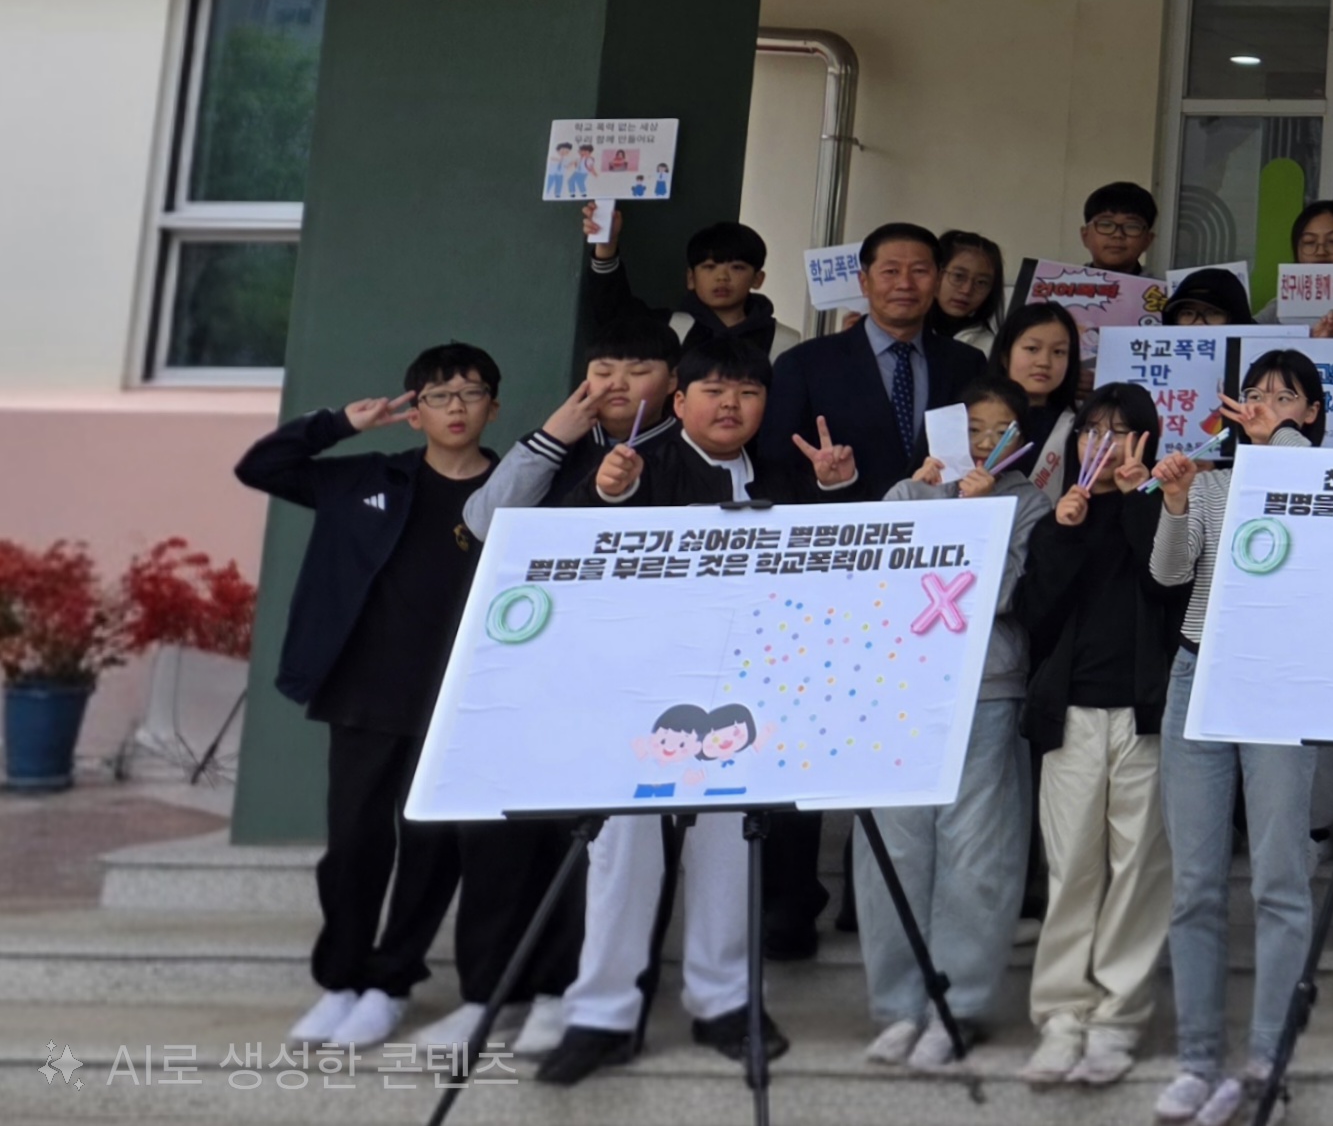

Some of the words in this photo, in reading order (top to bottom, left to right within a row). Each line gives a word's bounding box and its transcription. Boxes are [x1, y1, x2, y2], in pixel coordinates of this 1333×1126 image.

[1281, 274, 1312, 301] 친구사랑
[1130, 339, 1216, 361] 학교폭력
[1127, 364, 1171, 386] 그만
[593, 531, 673, 554] 친구가
[678, 527, 781, 553] 싫어하는
[788, 521, 915, 548] 별명이라도
[526, 558, 607, 582] 별명을
[612, 555, 691, 579] 부르는
[697, 552, 749, 577] 것은
[754, 547, 882, 575] 학교폭력이
[889, 543, 971, 569] 아니다.
